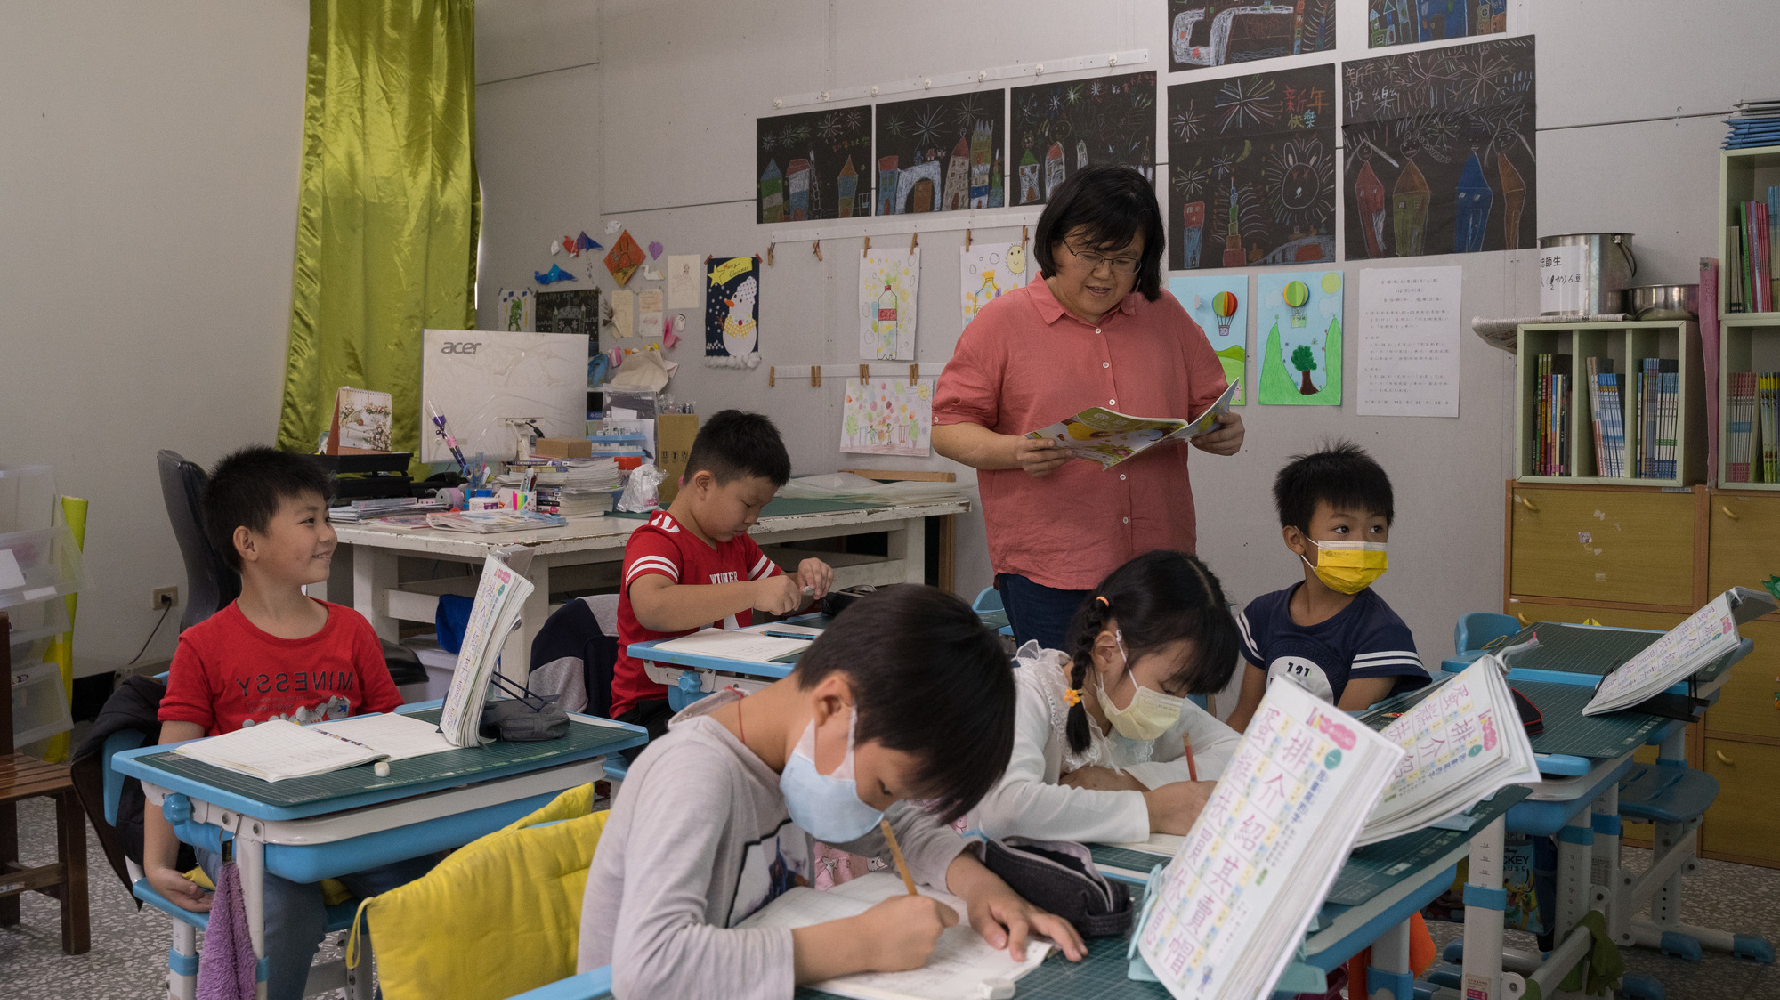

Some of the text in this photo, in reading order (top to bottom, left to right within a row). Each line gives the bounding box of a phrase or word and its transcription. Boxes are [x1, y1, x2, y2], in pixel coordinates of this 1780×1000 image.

[1283, 86, 1330, 114] 新年
[1346, 86, 1397, 118] 快樂
[440, 341, 482, 355] acer
[1503, 856, 1529, 864] CKEY
